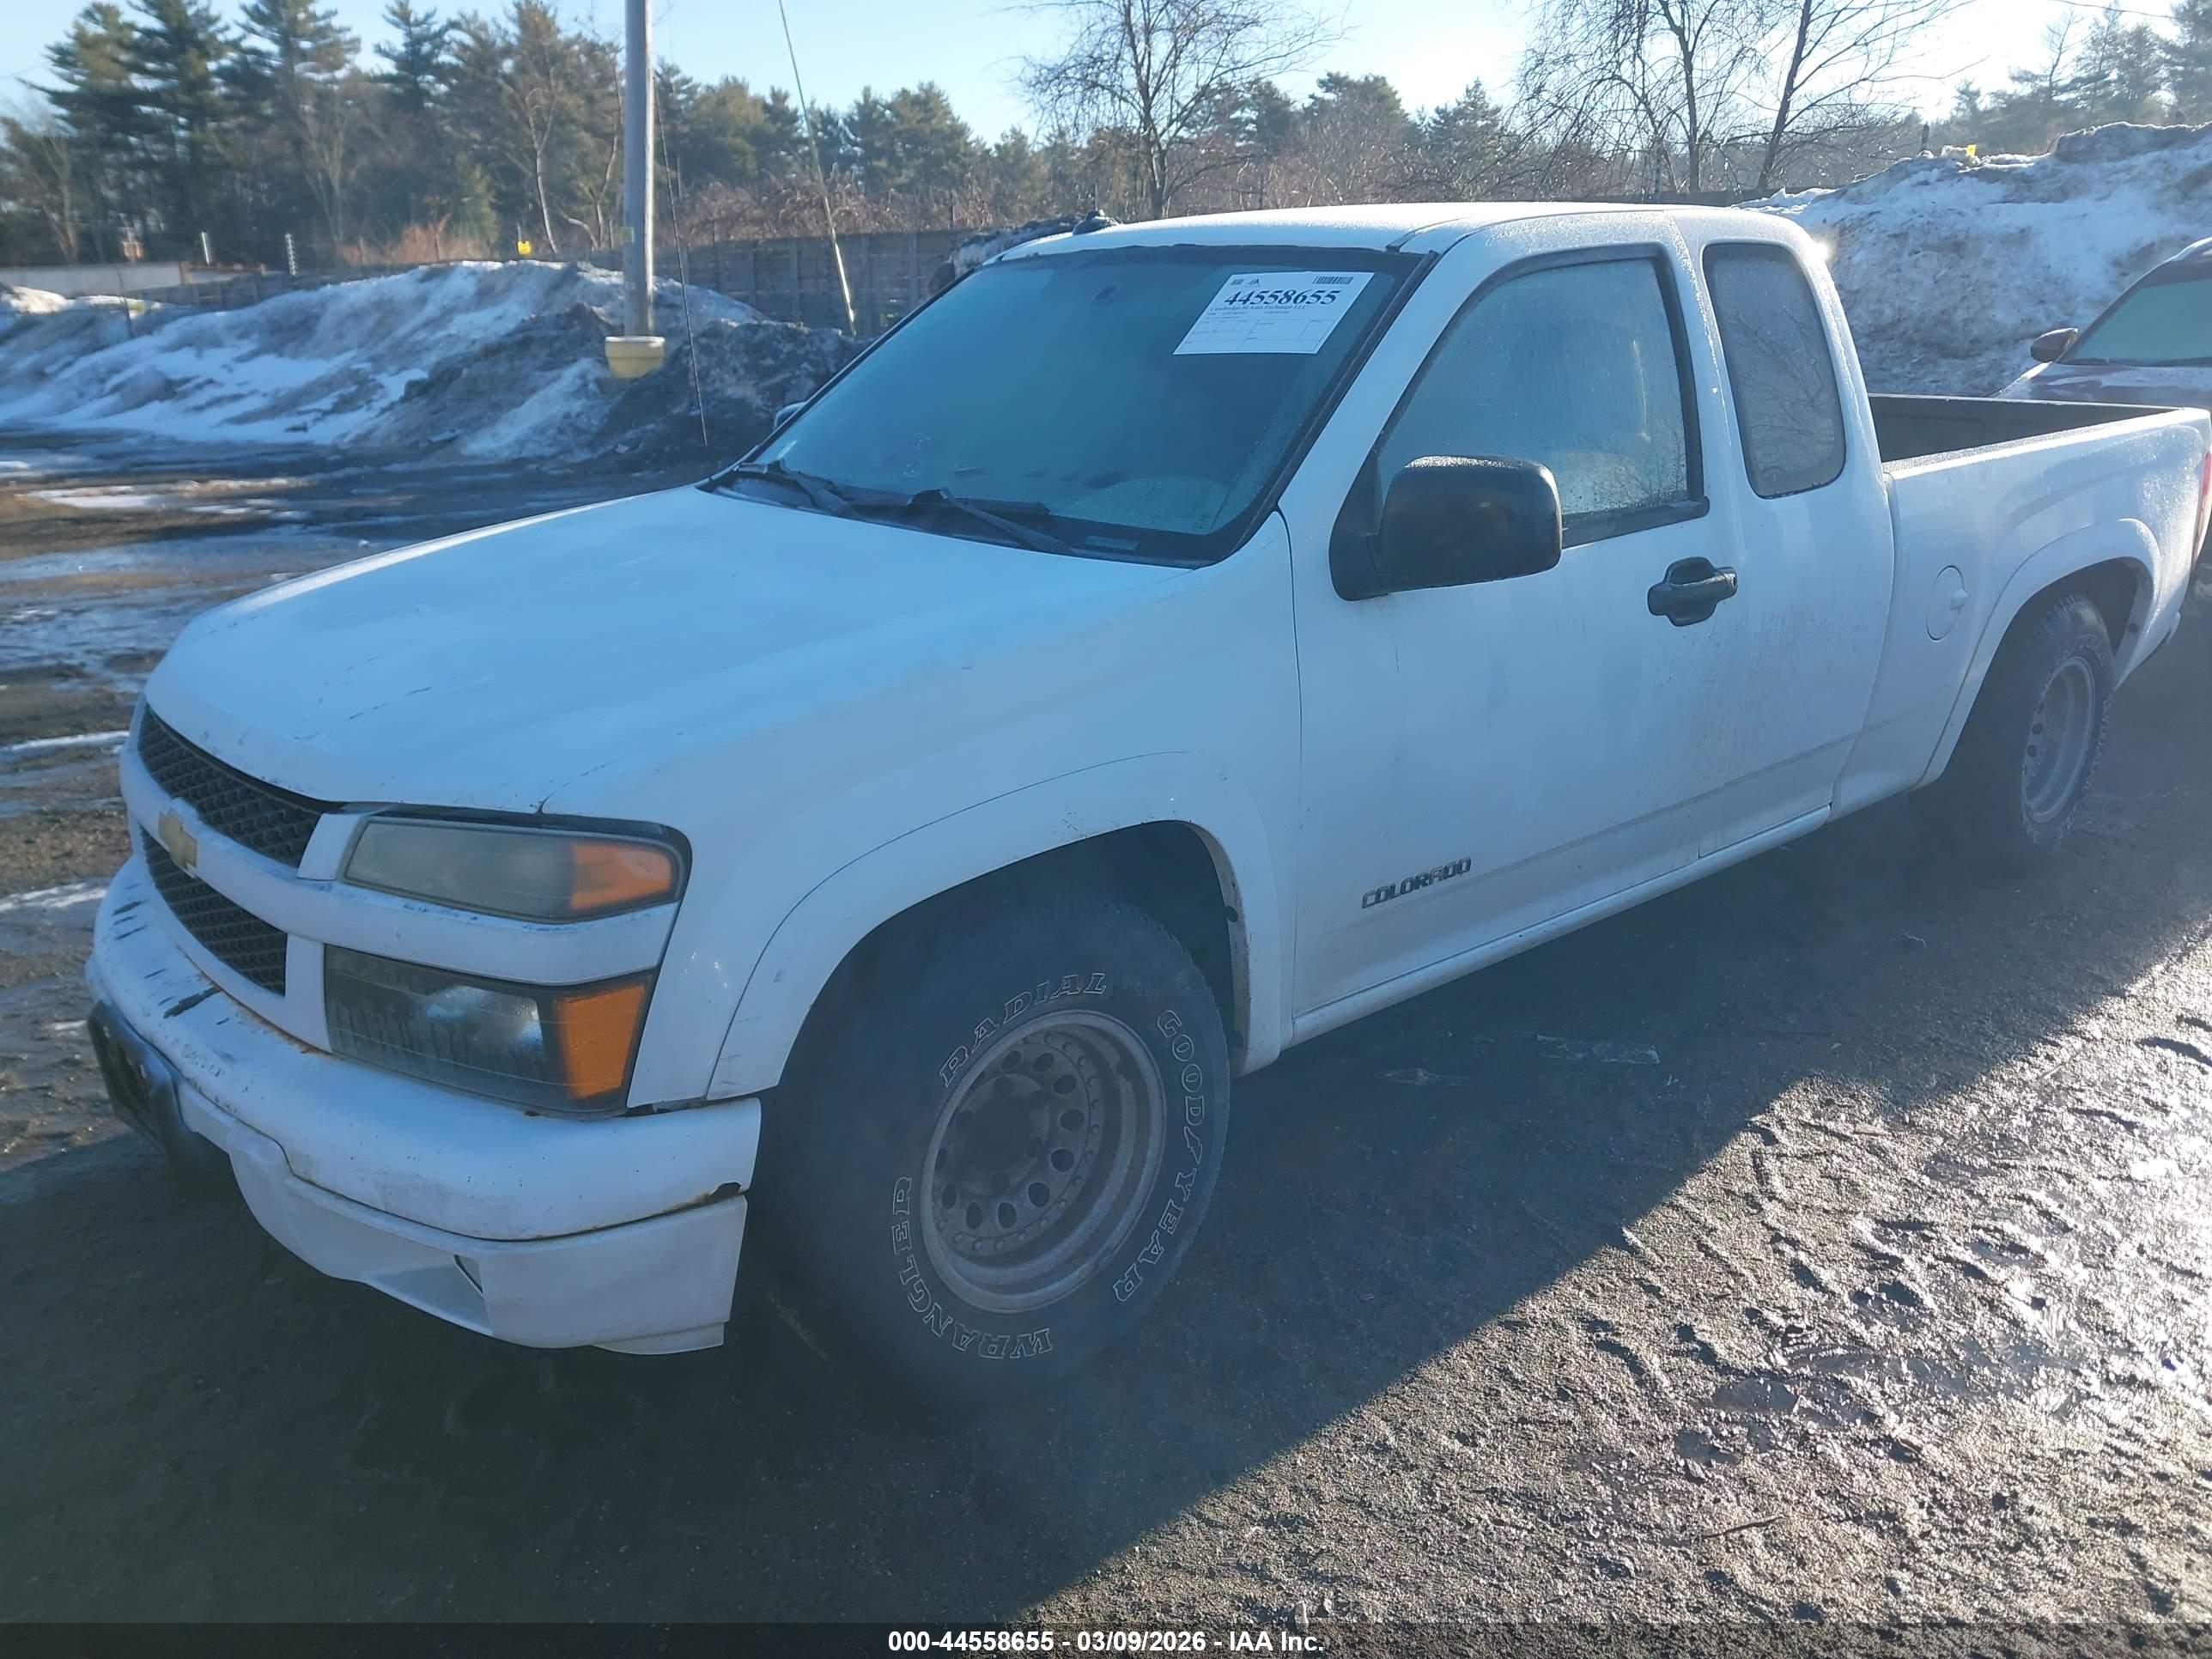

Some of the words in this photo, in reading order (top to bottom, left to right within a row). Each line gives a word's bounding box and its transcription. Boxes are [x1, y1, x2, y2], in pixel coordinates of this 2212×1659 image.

[1224, 289, 1341, 305] 44558655
[1362, 857, 1472, 908] COLORADO
[939, 972, 1107, 1086] RADIAL
[891, 1176, 1053, 1359] WRANGLER
